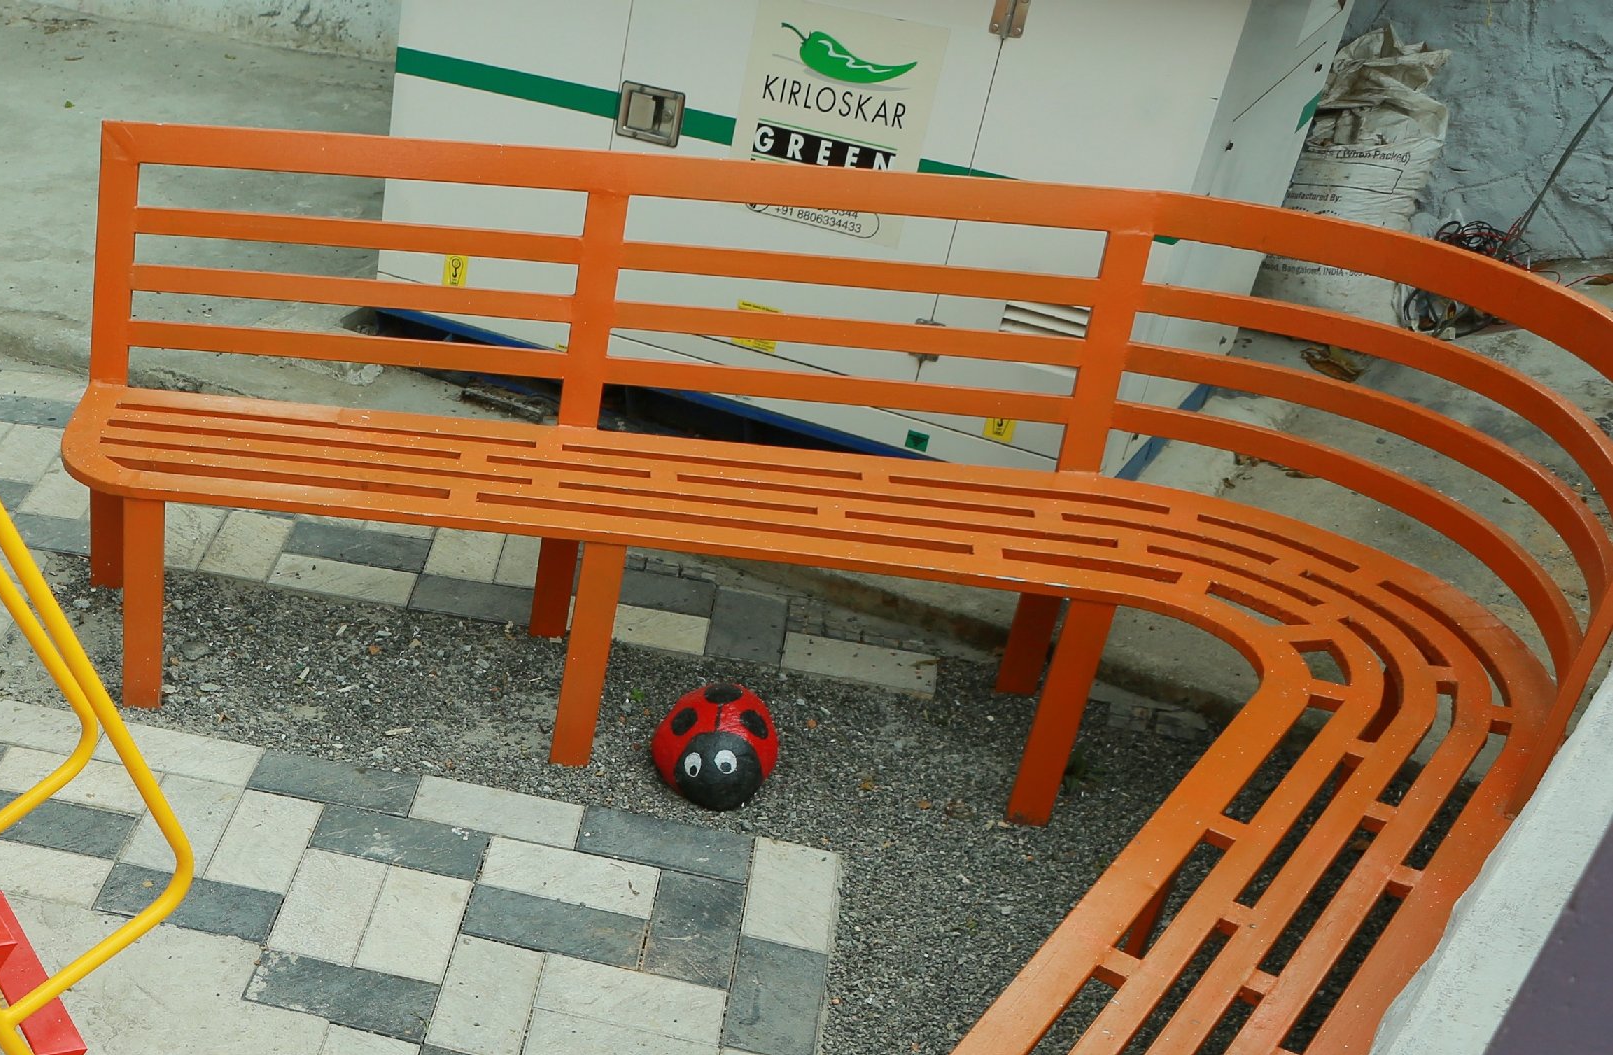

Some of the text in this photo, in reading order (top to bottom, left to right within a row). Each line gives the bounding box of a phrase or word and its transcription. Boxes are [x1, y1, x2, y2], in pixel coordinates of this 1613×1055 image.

[763, 75, 906, 129] KIRLOSKAR
[754, 126, 896, 172] GREEN
[796, 209, 863, 233] 8806334433
